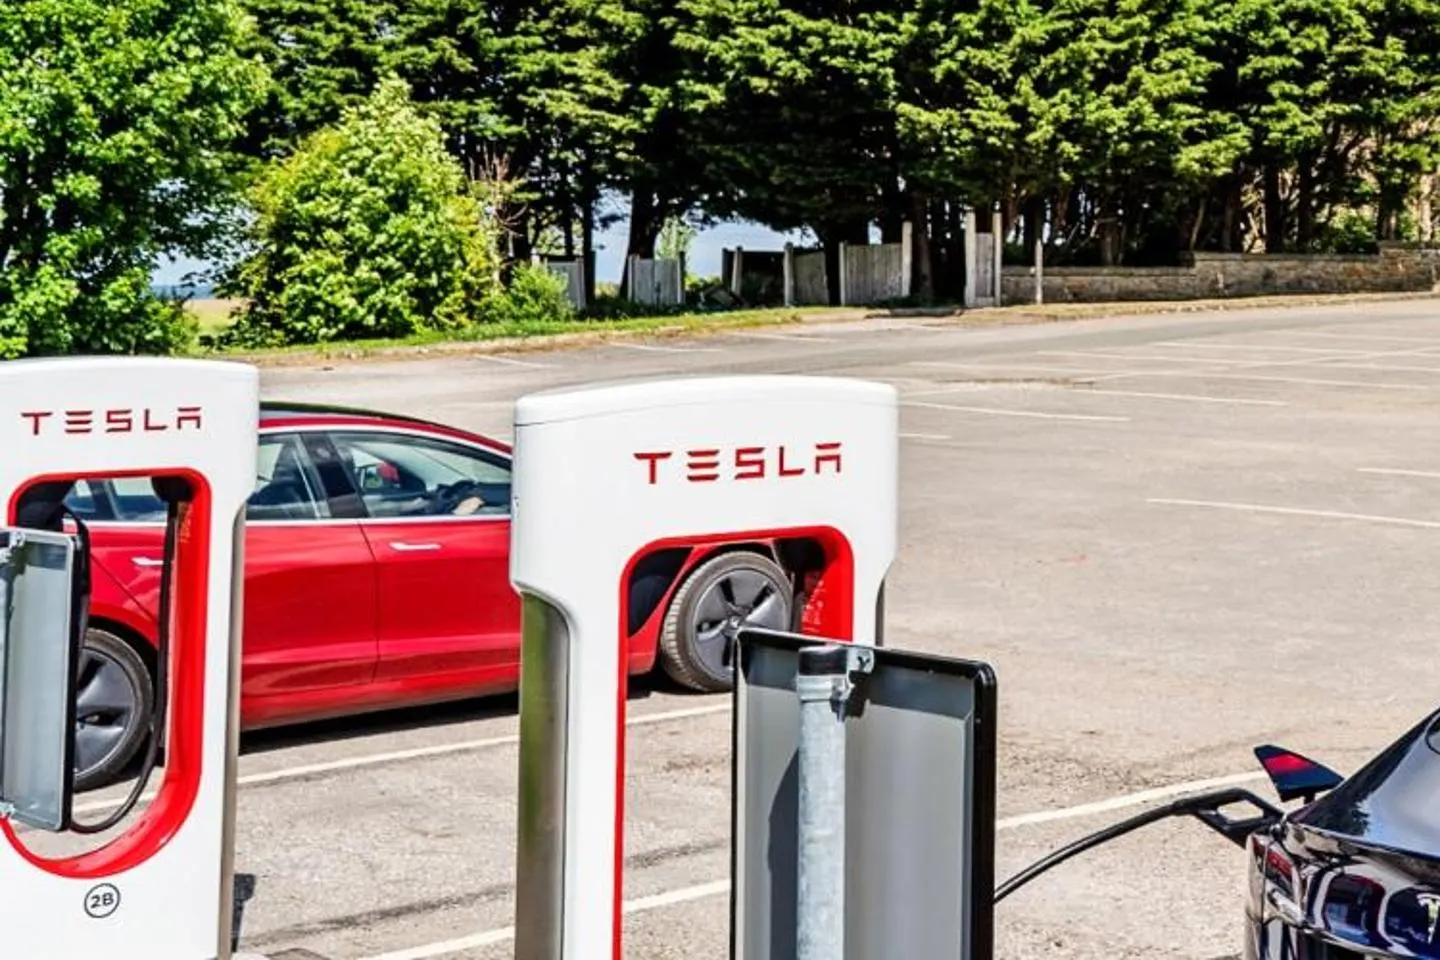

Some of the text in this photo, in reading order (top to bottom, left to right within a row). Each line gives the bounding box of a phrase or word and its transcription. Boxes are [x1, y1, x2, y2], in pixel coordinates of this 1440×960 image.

[20, 406, 202, 436] TESLA
[633, 442, 842, 485] TESLA
[90, 892, 114, 909] 2B
